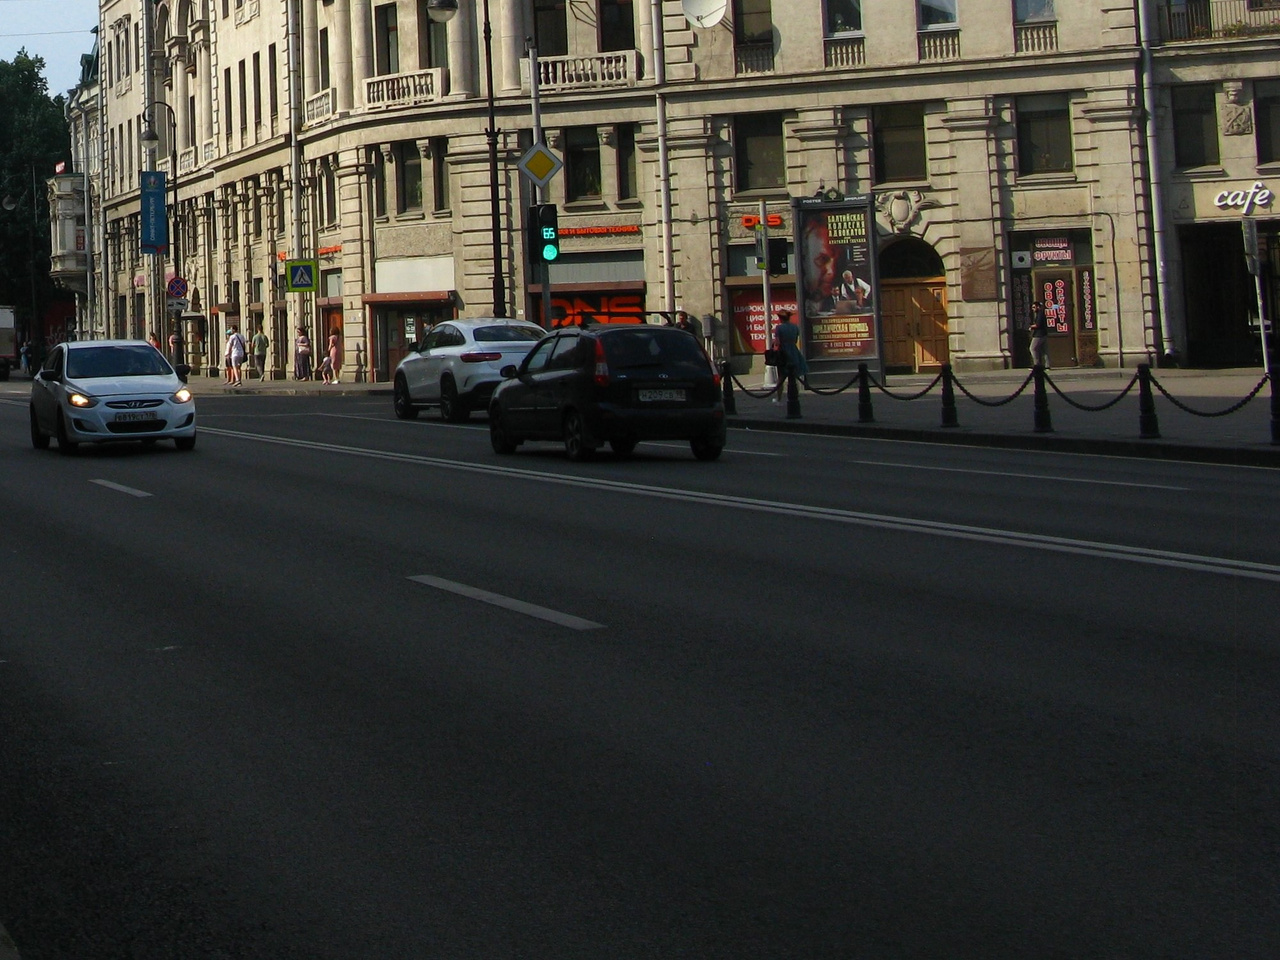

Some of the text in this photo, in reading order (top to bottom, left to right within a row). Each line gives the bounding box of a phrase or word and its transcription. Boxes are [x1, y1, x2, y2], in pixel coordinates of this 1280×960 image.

[1214, 181, 1270, 214] cafe
[543, 227, 556, 239] 65
[1035, 238, 1068, 248] ОВОЩИ
[1034, 250, 1071, 261] ФРУКТЫ
[775, 303, 798, 311] ВЫБО
[1044, 282, 1057, 327] ОВОЩИ
[1055, 279, 1068, 332] ФРУКТЫ
